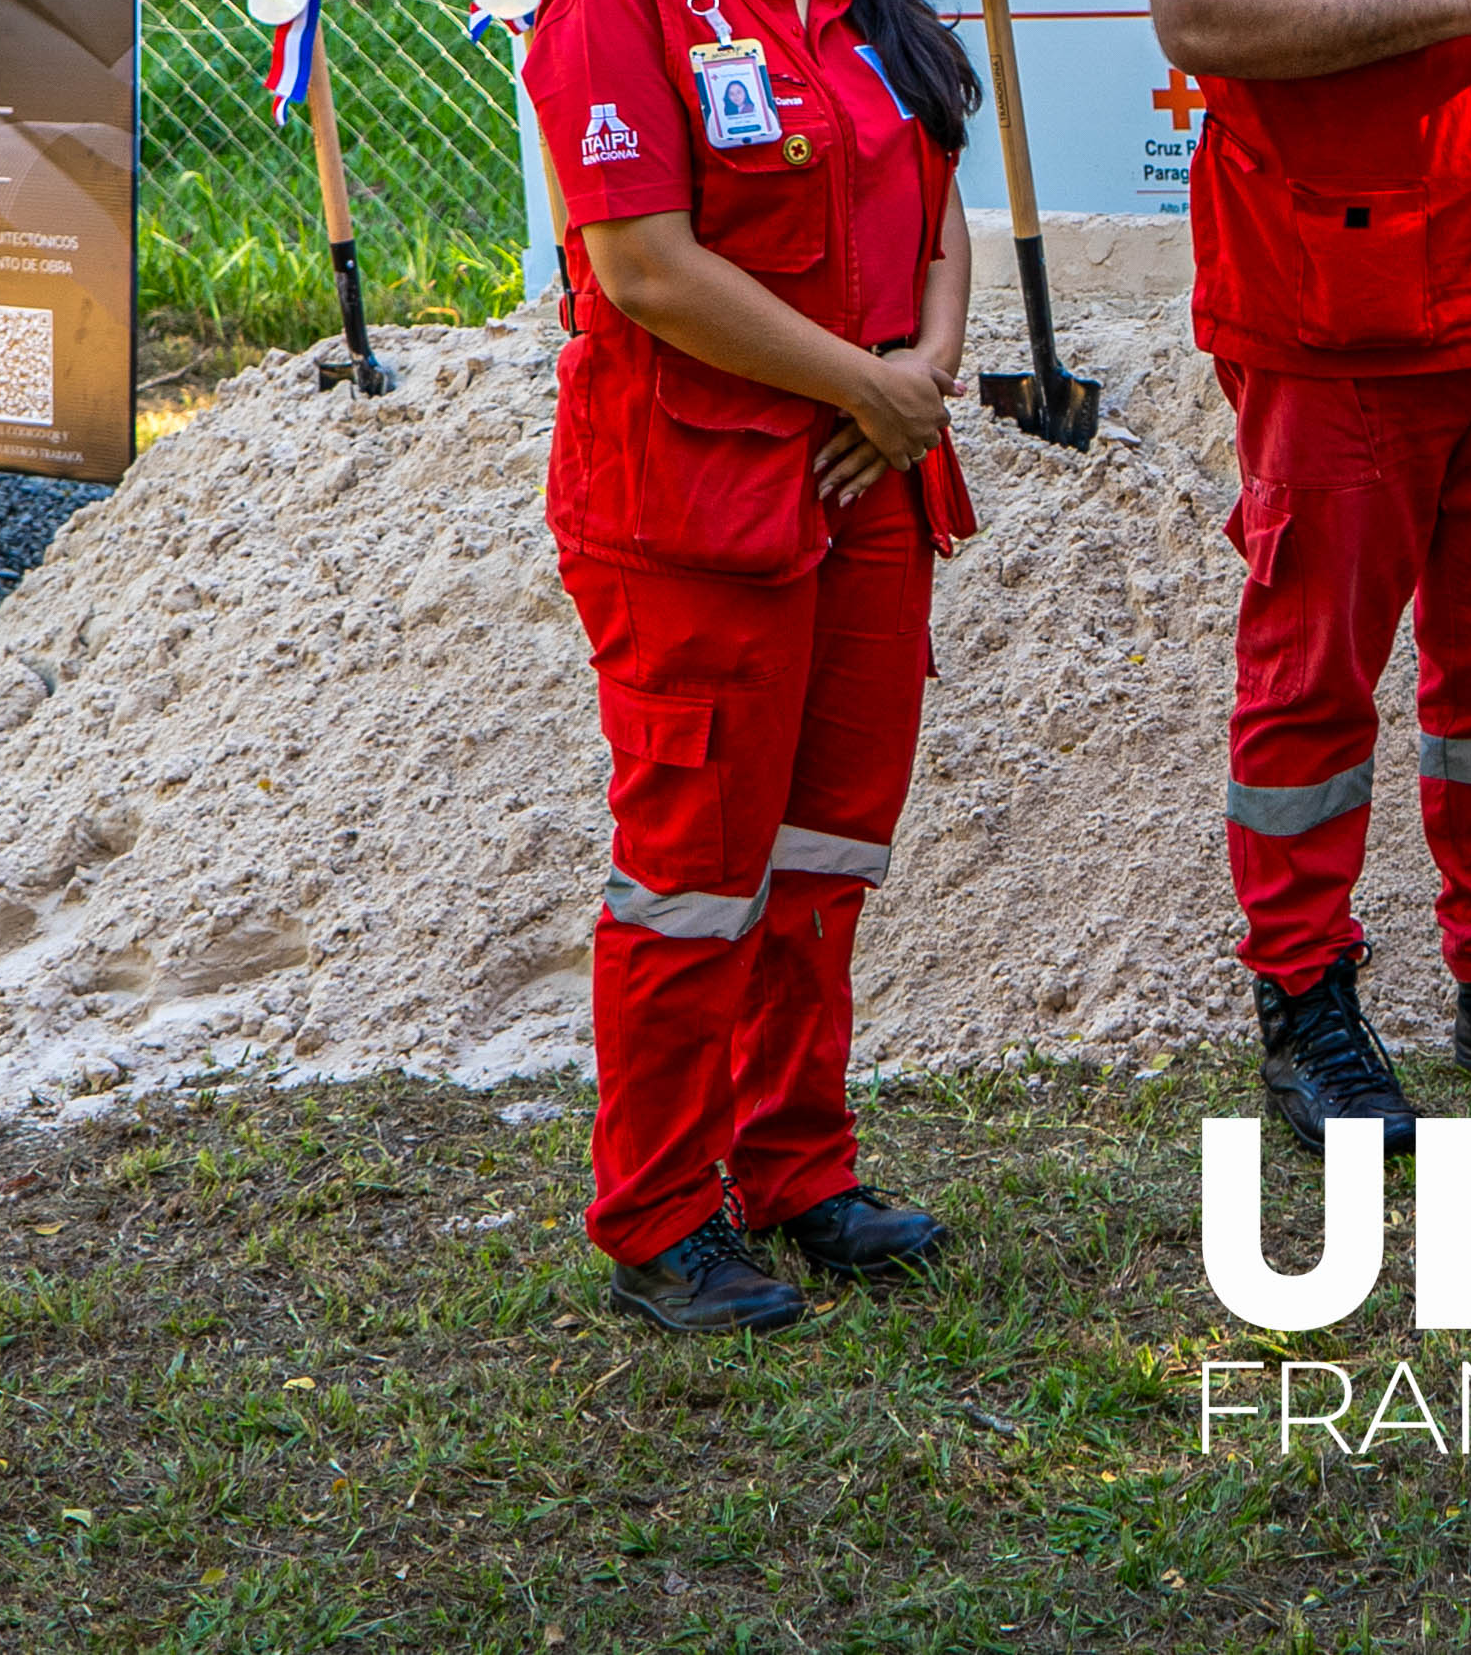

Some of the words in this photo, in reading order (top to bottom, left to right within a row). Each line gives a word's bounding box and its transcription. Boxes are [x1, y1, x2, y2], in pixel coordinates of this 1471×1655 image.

[992, 60, 1009, 121] TRAMONTINA
[582, 130, 638, 156] ITAIPU
[1145, 139, 1182, 156] Cruz
[22, 257, 38, 272] DE
[39, 258, 73, 274] OBRA
